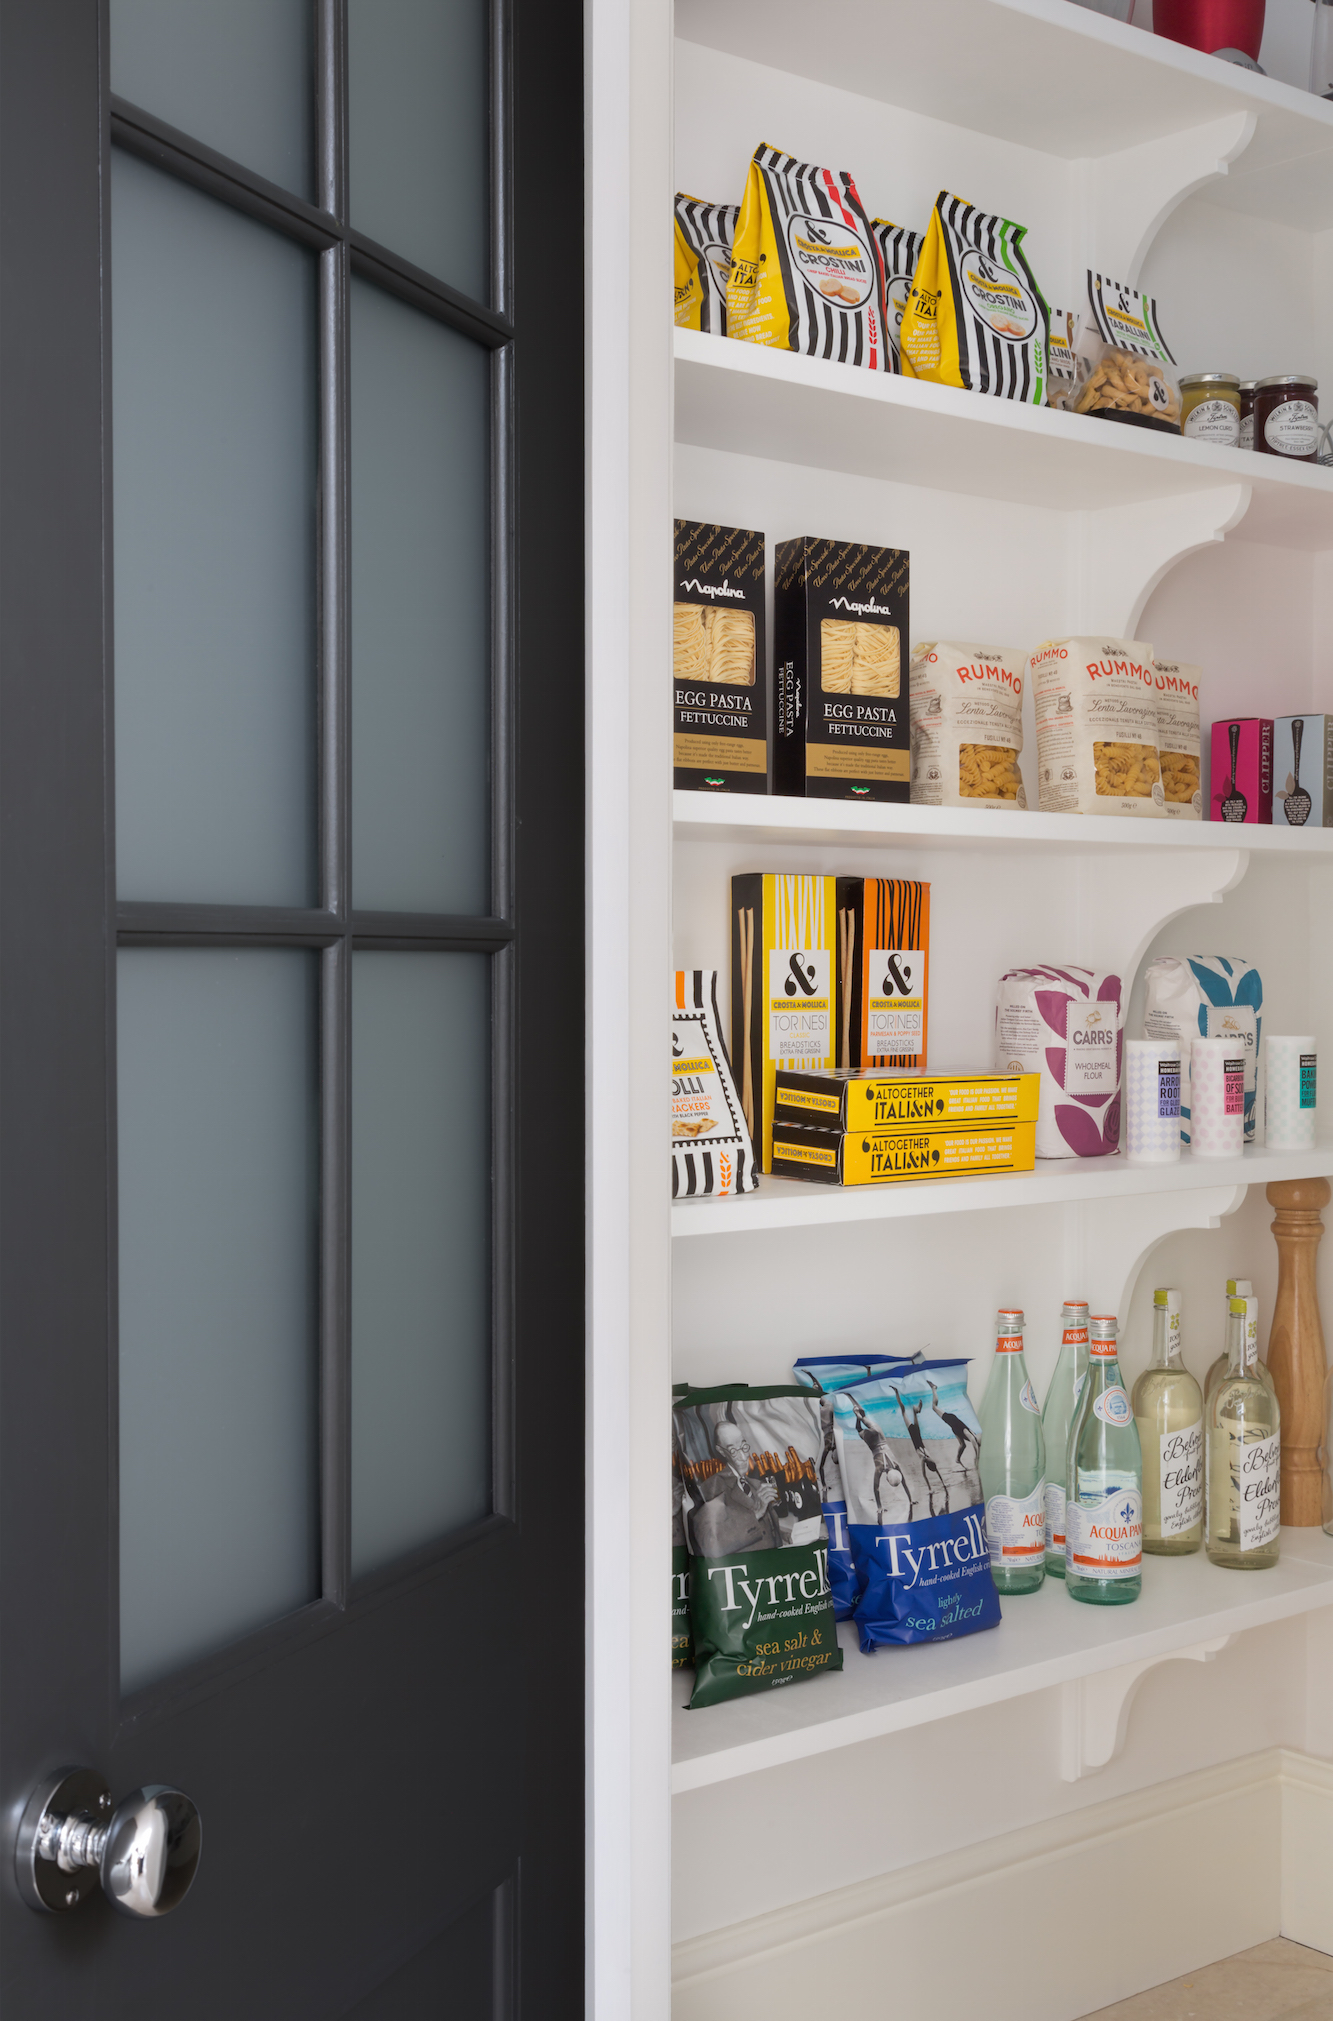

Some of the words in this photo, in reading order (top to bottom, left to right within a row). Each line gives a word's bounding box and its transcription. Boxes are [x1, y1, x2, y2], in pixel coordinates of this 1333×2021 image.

[799, 250, 867, 273] CROSTINI
[826, 266, 846, 275] CHILLI
[972, 284, 1027, 312] CROSTINI
[987, 303, 1015, 314] OREGANO
[1108, 317, 1151, 341] TARALLINI
[1190, 406, 1205, 422] WILKIN
[1271, 406, 1287, 422] WILKIN
[680, 578, 746, 600] Napolina
[828, 596, 891, 616] Napolina
[1030, 648, 1068, 669] RUMMO
[786, 661, 794, 690] EGG
[956, 663, 1022, 695] RUMMO
[1086, 659, 1152, 687] RUMMO
[1154, 667, 1198, 701] UMMO
[675, 690, 706, 706] EGG
[709, 692, 752, 711] PASTA
[956, 702, 986, 716] Lenta
[1087, 699, 1116, 713] Lenta
[680, 711, 749, 728] FETTUCCINE
[786, 694, 794, 737] PASTA
[824, 703, 853, 719] EGG
[856, 705, 897, 723] PASTA
[828, 723, 893, 739] FETTUCCINE
[1262, 724, 1270, 794] CLIPPER
[773, 1001, 796, 1009] CROSTA
[801, 1001, 826, 1009] MOLLICA
[871, 1001, 893, 1009] CROSTA
[773, 1014, 828, 1031] TORINESI
[871, 1014, 921, 1030] TORINESI
[789, 1031, 811, 1039] CLASSIC
[876, 1039, 914, 1048] BREADSTICKS
[1073, 1029, 1113, 1045] CARR'S
[779, 1040, 821, 1049] BREADSTICKS
[804, 1047, 821, 1055] GRISSINI
[673, 1061, 710, 1072] MOLLICA
[1075, 1062, 1111, 1071] WHOLEMEAL
[1083, 1071, 1103, 1080] FLOUR
[875, 1087, 934, 1100] ALTOGETHER
[871, 1138, 930, 1152] ALTOGETHER
[1171, 1516, 1192, 1530] English
[1089, 1524, 1128, 1542] ACQUA
[1251, 1529, 1272, 1543] English
[919, 1568, 960, 1587] hand-cooked
[961, 1562, 982, 1577] English
[708, 1548, 832, 1630] Tyrrell
[757, 1605, 803, 1623] hand-cooked
[804, 1602, 827, 1616] English
[905, 1616, 936, 1631] sea
[940, 1599, 984, 1628] salted
[756, 1642, 780, 1656] sea
[784, 1632, 808, 1652] salt
[811, 1628, 823, 1645] &
[736, 1661, 777, 1677] cider
[781, 1651, 832, 1672] vinegar
